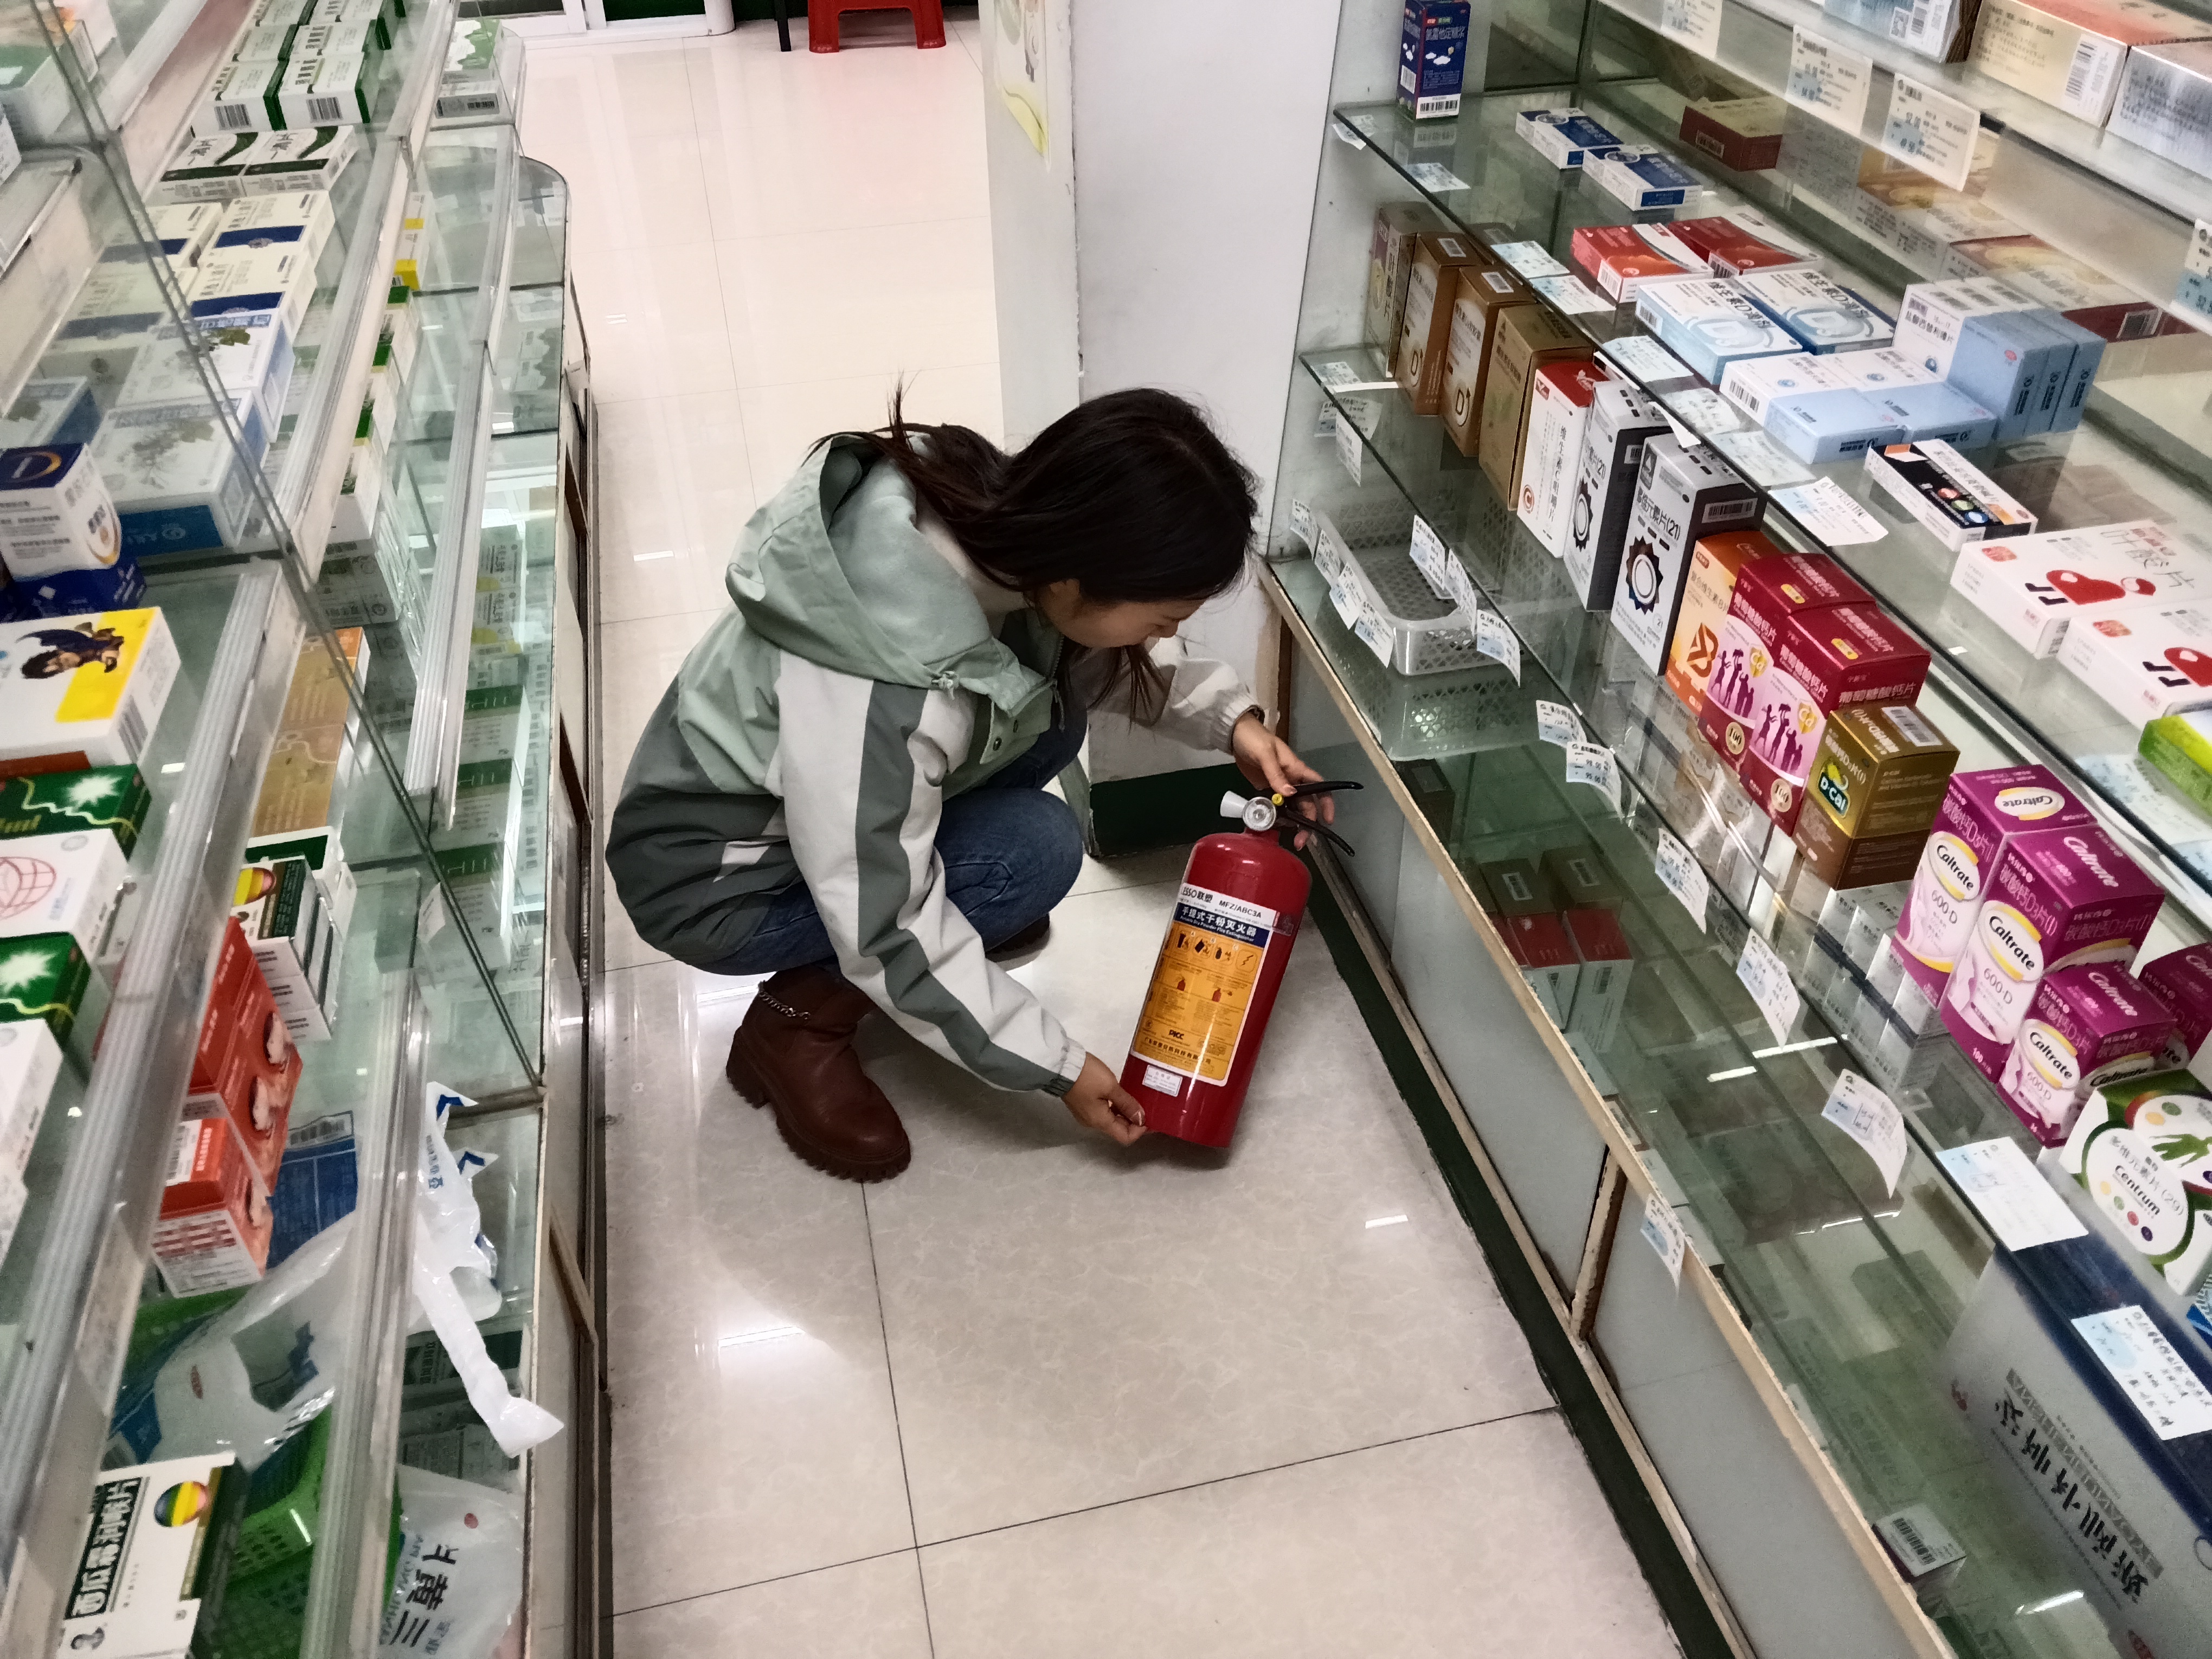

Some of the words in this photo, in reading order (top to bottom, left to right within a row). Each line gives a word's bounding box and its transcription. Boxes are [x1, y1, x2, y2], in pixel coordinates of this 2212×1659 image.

[1729, 728, 1741, 745] 100
[1774, 784, 1790, 803] 100
[2001, 794, 2054, 808] Caltrate
[1937, 845, 1975, 891] Caltrate
[2063, 836, 2119, 888] Caltrate
[1182, 906, 1257, 937] 手提式干粉灭火器
[1219, 900, 1262, 918] MFZ/ABC3A
[1989, 916, 2035, 971] Caltrate
[2088, 972, 2138, 1017] Caltrate
[1168, 1029, 1185, 1040] PICC
[2029, 1031, 2073, 1080] Caltrate
[2115, 1165, 2160, 1215] Centrum
